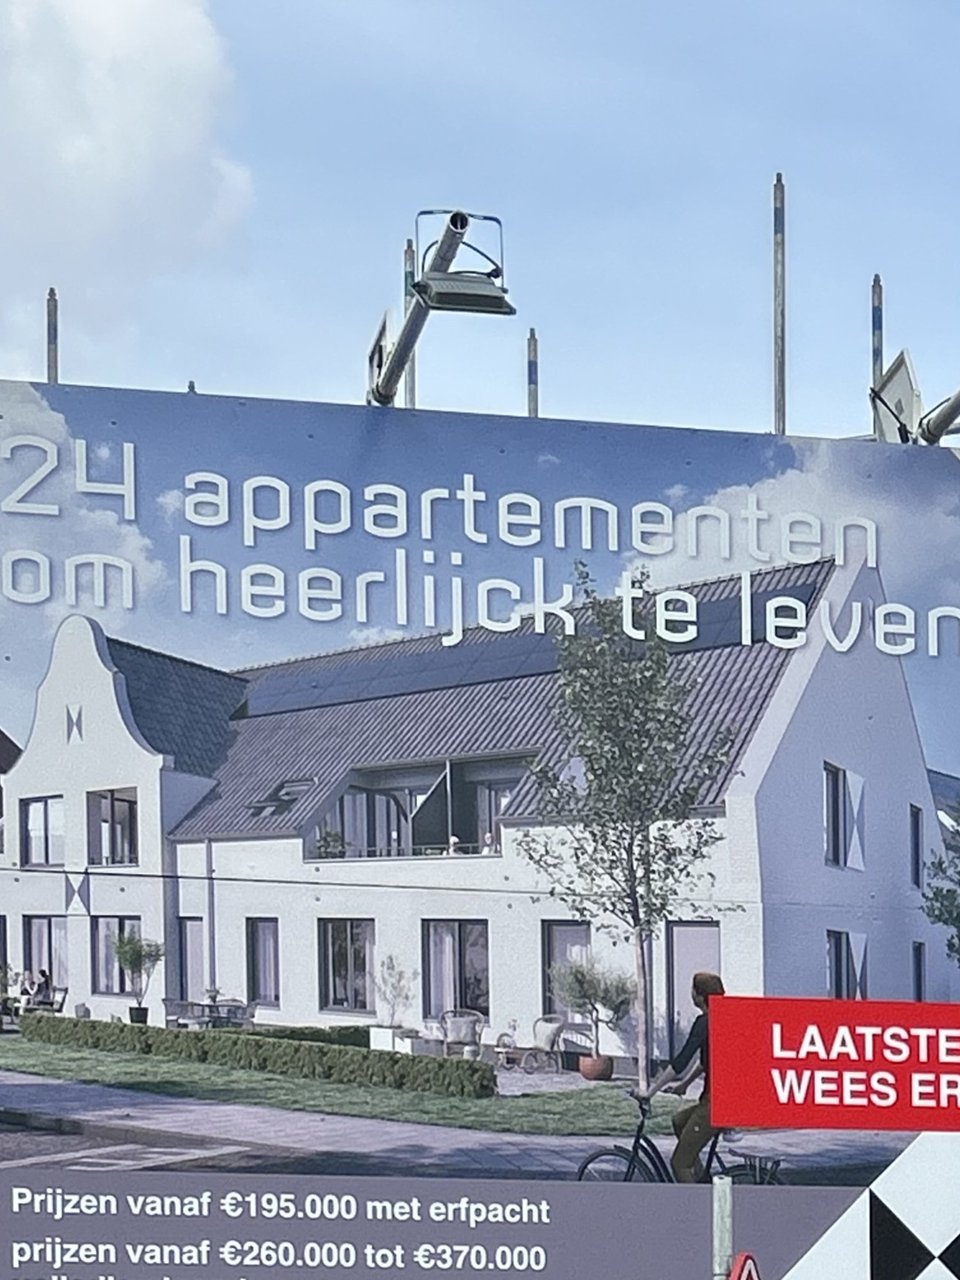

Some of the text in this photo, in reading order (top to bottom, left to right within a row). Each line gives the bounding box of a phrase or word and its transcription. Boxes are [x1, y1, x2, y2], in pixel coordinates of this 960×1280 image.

[2, 434, 877, 568] 24 appartementen
[2, 549, 134, 609] om
[179, 535, 576, 646] heerlijck
[615, 570, 698, 643] te
[771, 1069, 898, 1107] WEES
[12, 1187, 551, 1228] Prijzen vanaf €195.000 met erfpacht
[12, 1237, 547, 1271] prijzen vanaf €260.000 tot €370.000
